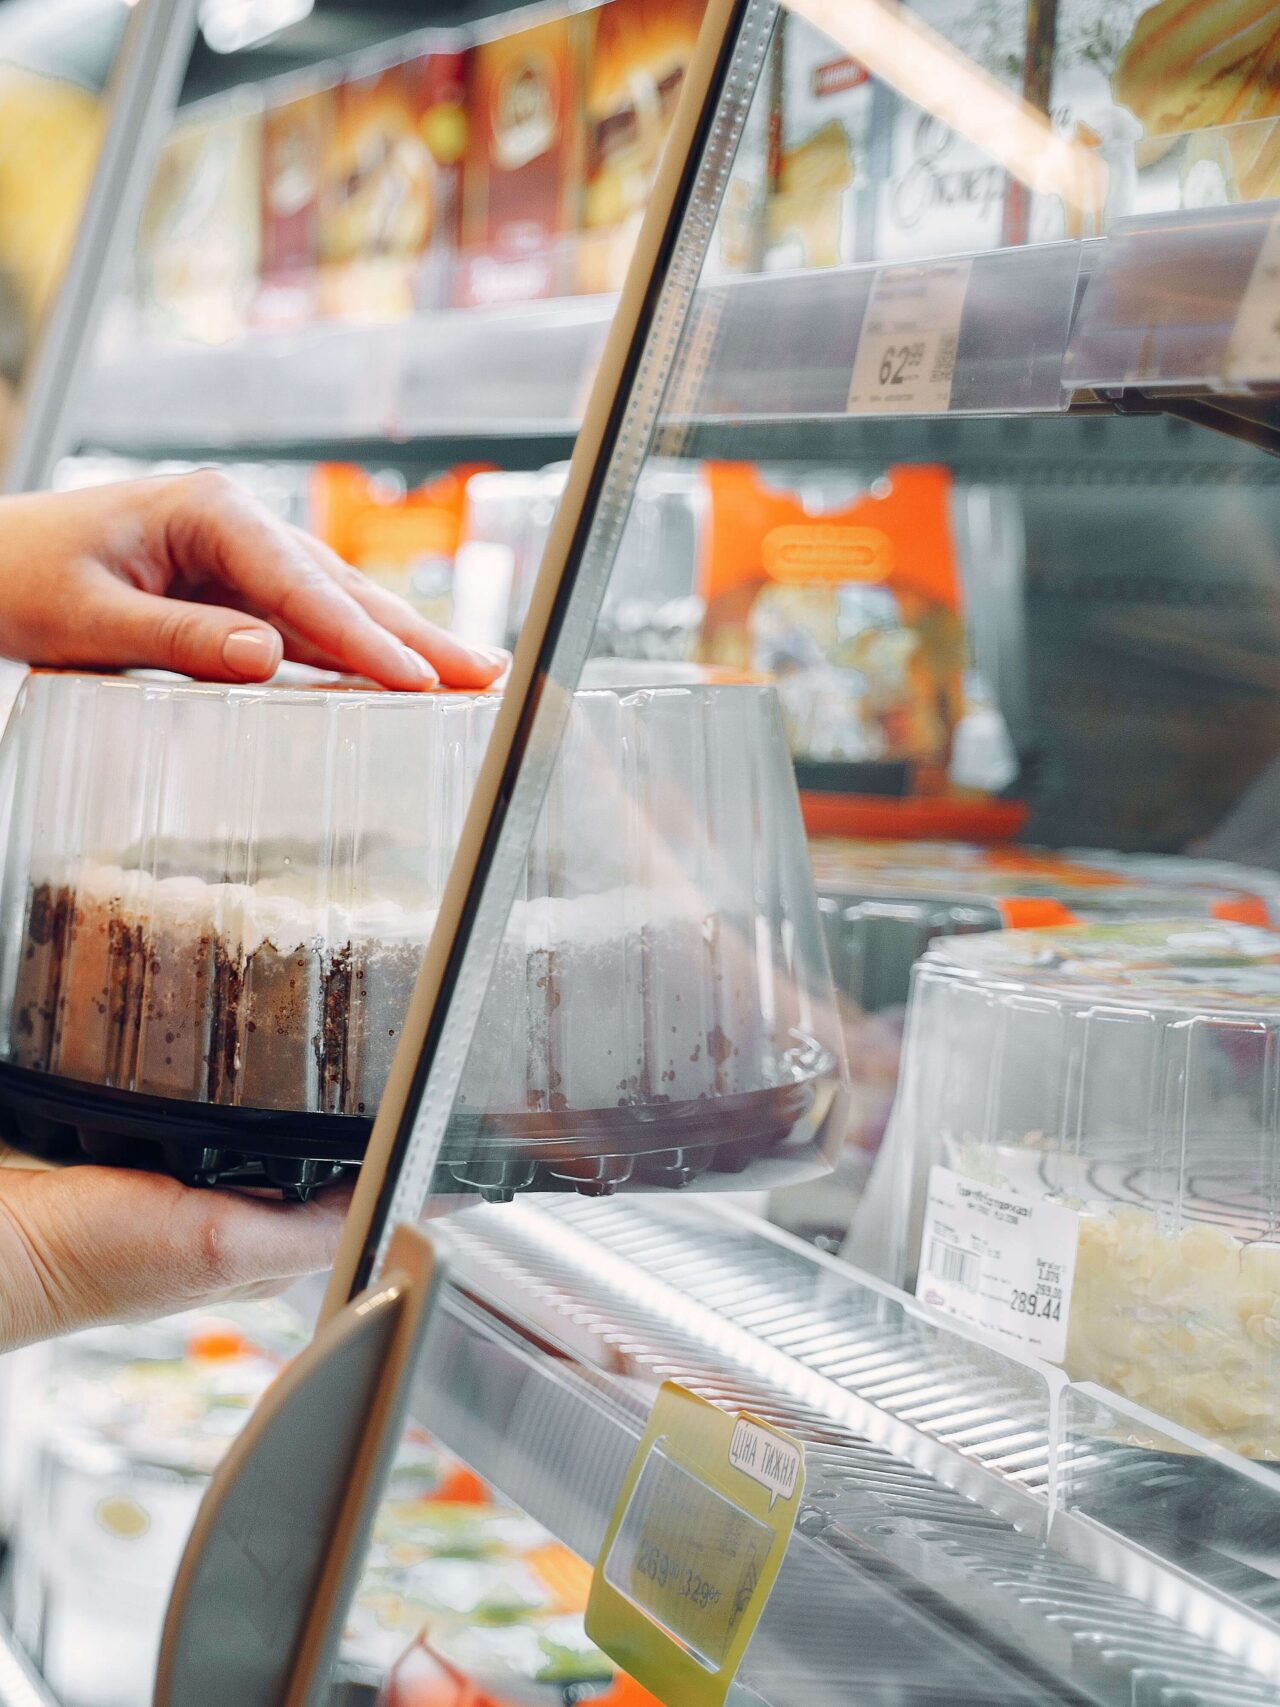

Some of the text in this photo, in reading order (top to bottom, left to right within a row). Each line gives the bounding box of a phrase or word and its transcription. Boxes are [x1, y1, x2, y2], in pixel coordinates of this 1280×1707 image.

[1010, 1288, 1062, 1322] 289.44
[731, 1423, 796, 1488] ЦІНА ТИЖНЯ
